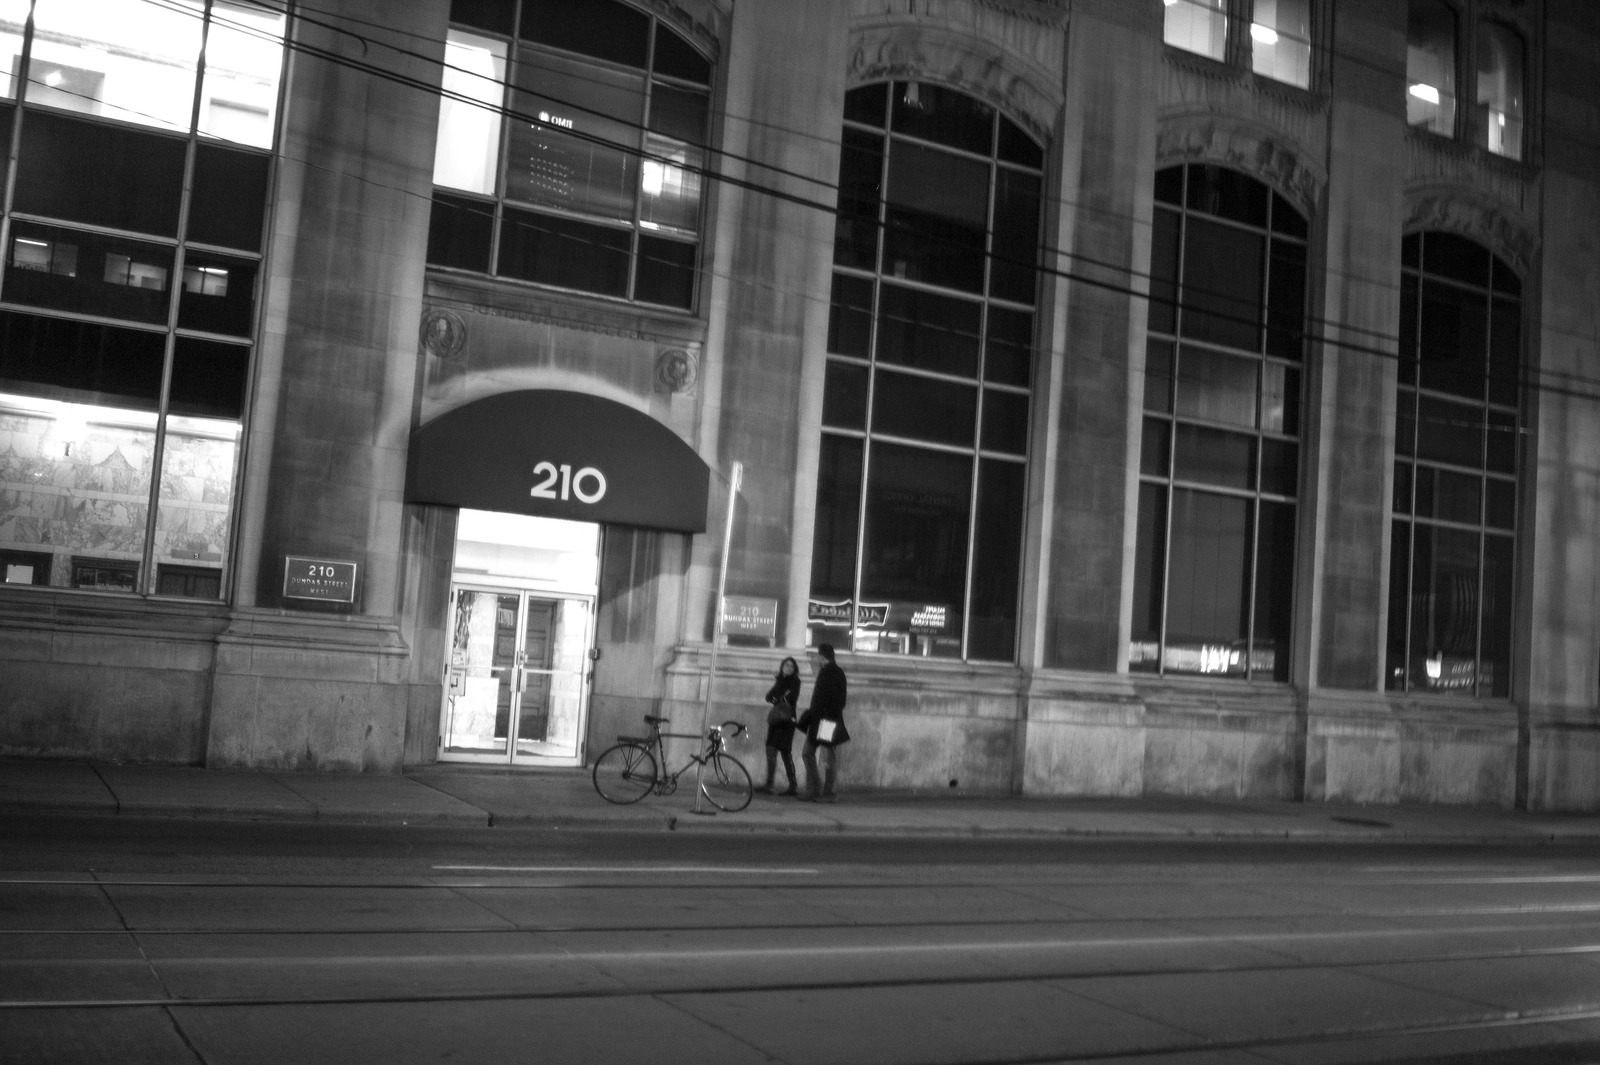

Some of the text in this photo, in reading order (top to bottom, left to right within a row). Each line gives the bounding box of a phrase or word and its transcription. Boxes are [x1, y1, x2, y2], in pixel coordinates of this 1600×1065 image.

[530, 461, 607, 504] 210
[309, 565, 335, 577] 210
[292, 577, 320, 585] DUNDAS
[740, 606, 760, 617] 210
